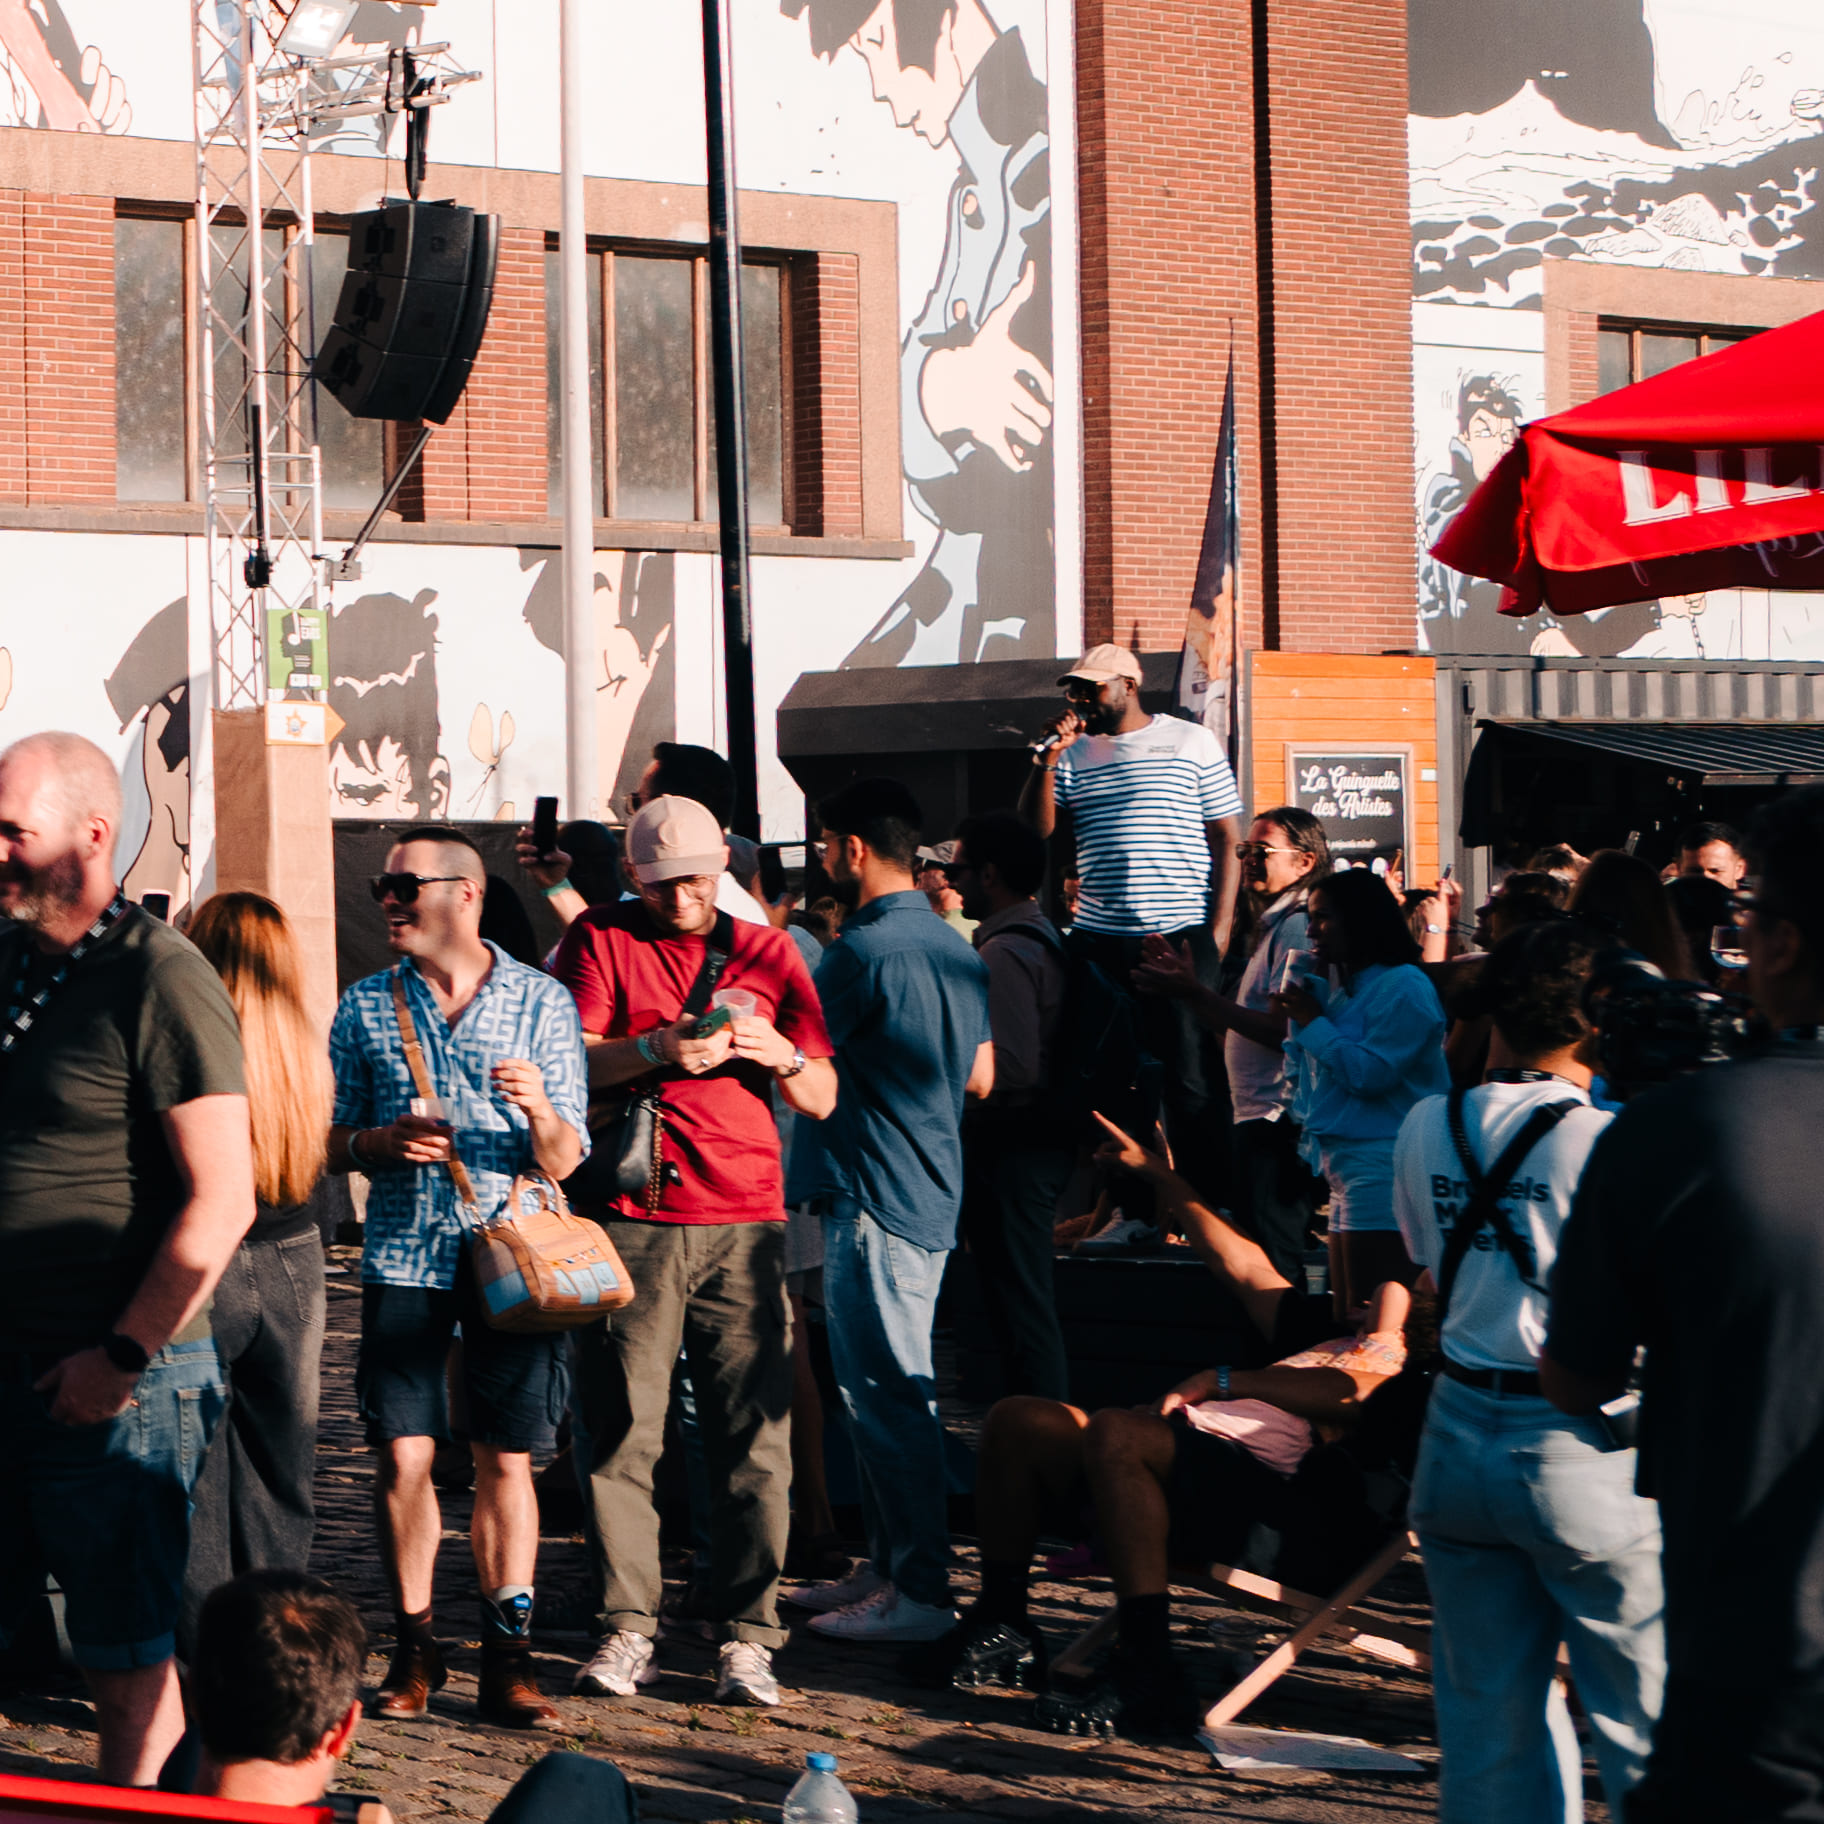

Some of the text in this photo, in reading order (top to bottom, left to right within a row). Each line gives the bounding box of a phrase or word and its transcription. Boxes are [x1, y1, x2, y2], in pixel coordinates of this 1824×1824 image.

[1615, 446, 1824, 526] LIL
[1299, 765, 1400, 798] La Guinguette
[1311, 791, 1394, 820] des Artistes
[1431, 1174, 1550, 1203] Brels
